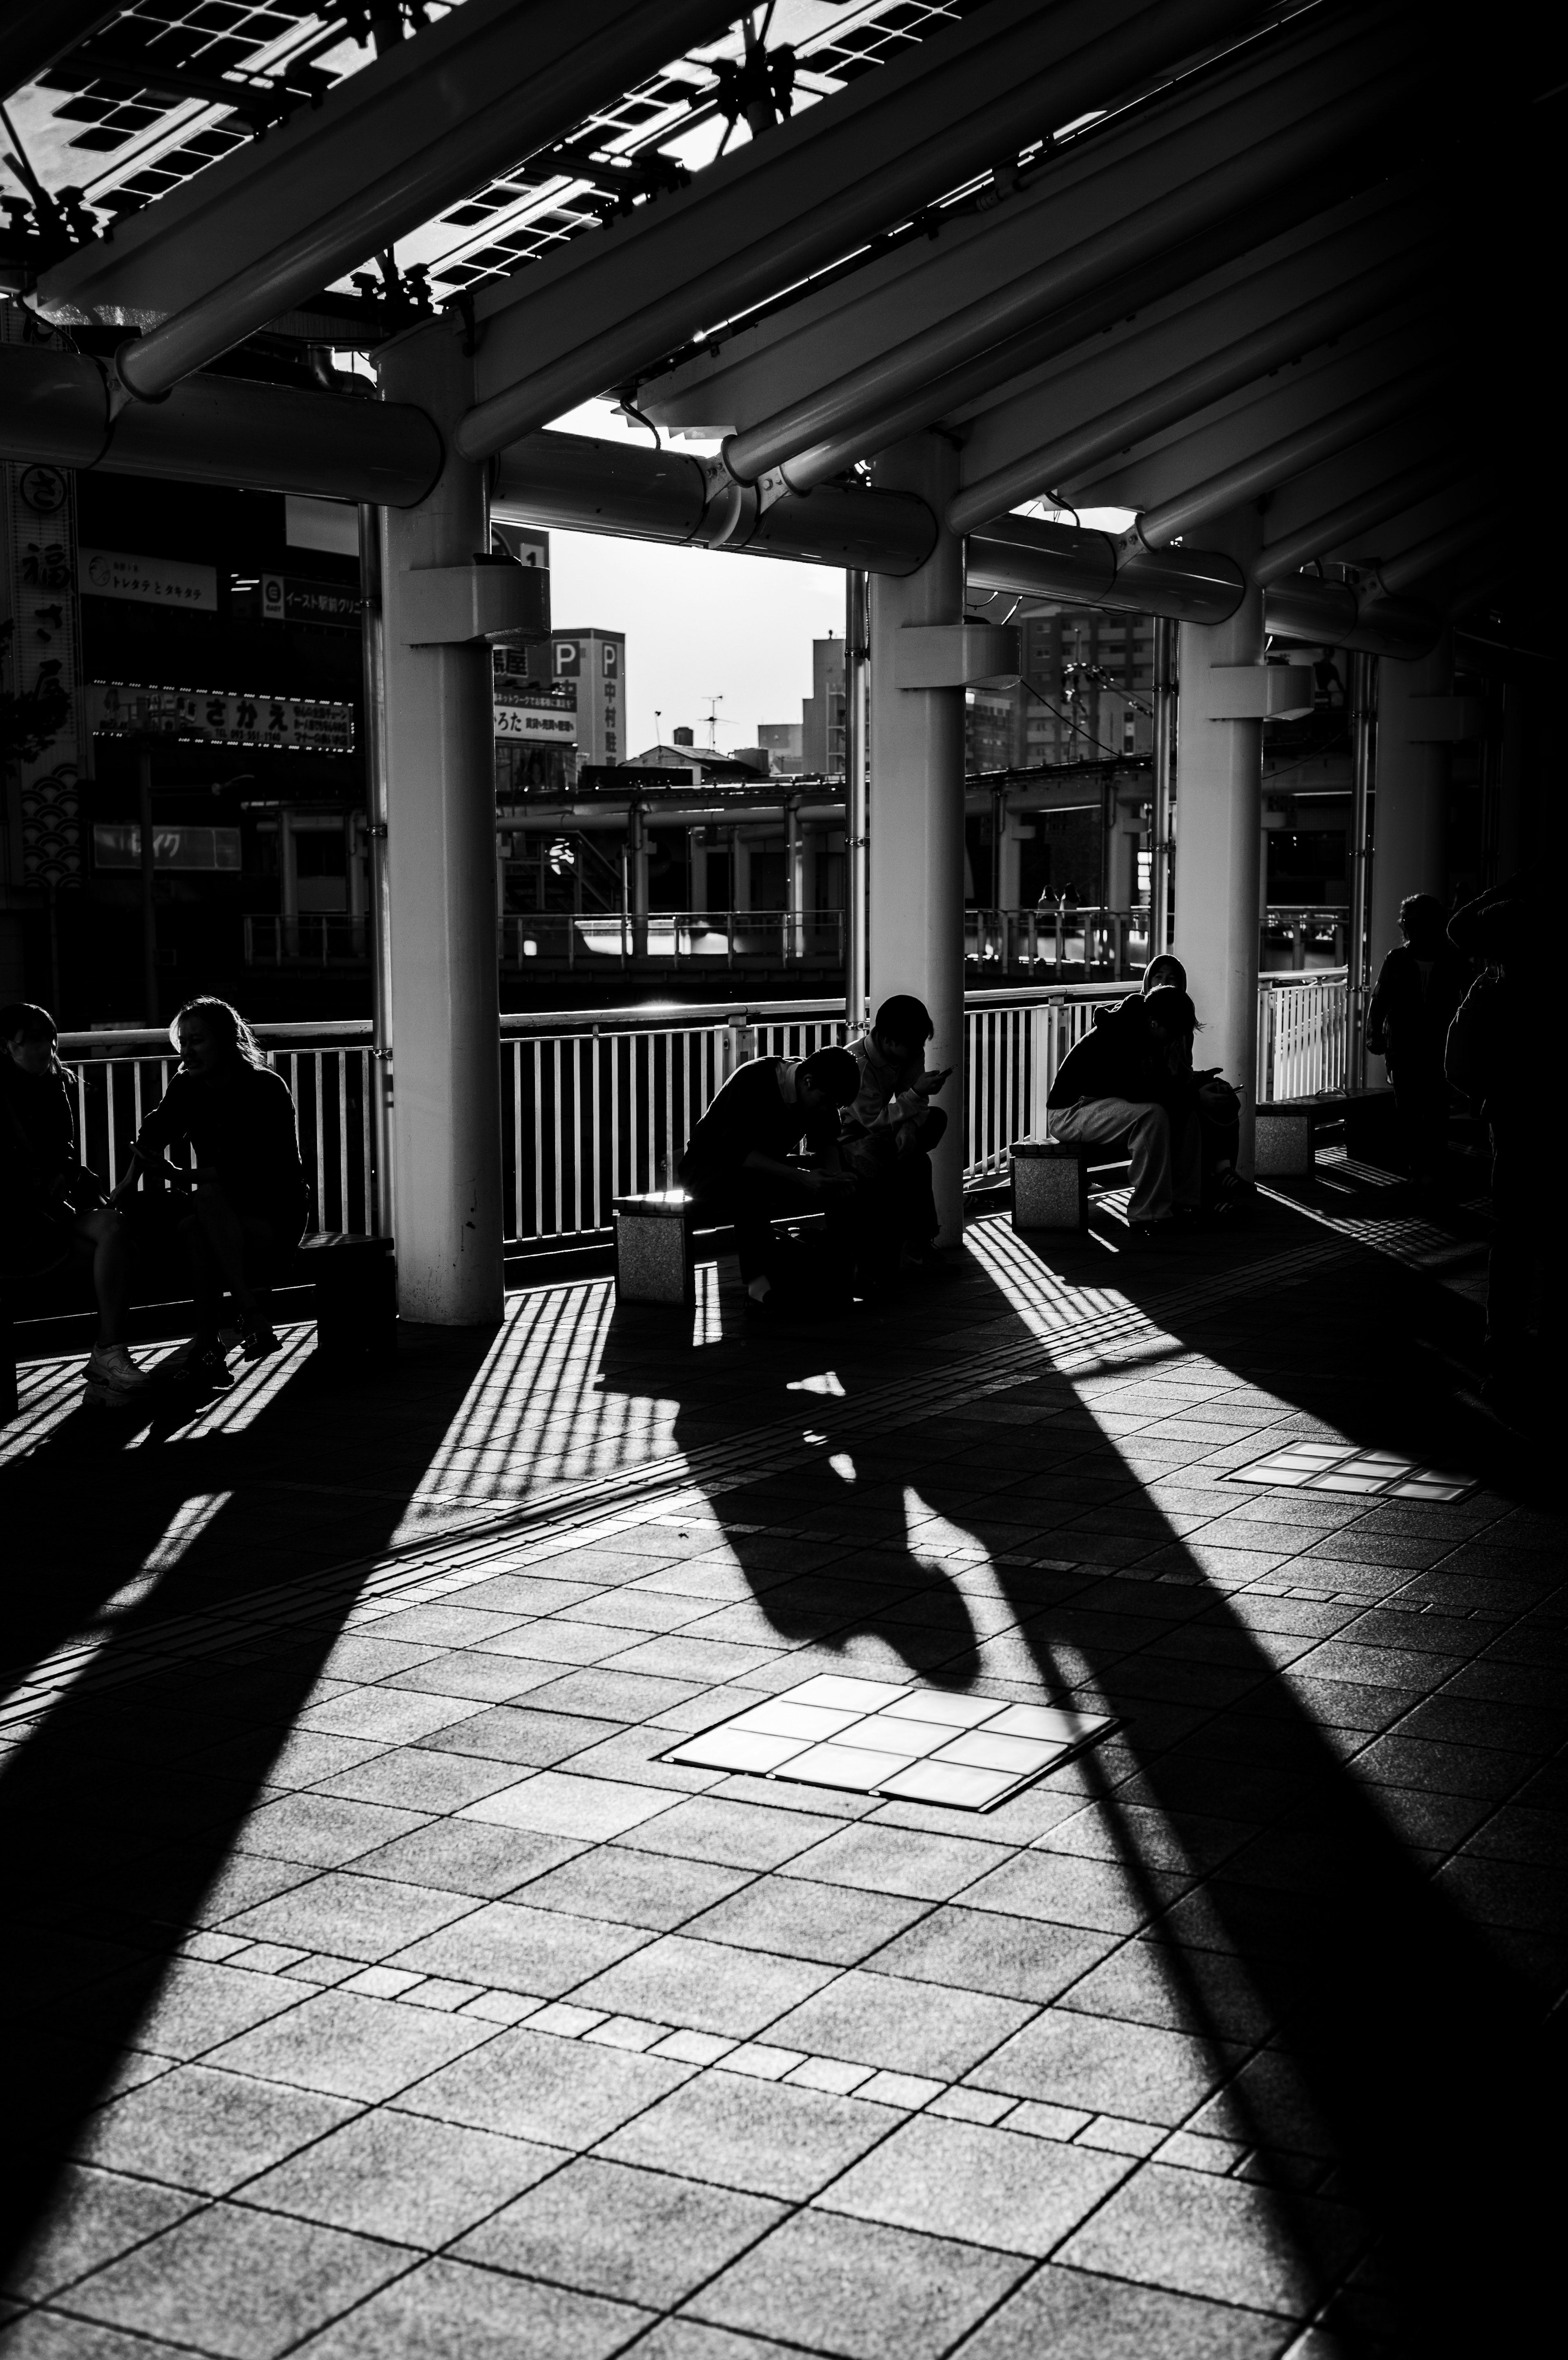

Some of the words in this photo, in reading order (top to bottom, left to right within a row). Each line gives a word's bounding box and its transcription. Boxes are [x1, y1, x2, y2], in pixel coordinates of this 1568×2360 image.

[556, 644, 576, 674] P
[604, 645, 615, 675] P
[206, 698, 287, 731] さかえ
[494, 712, 522, 732] ろた
